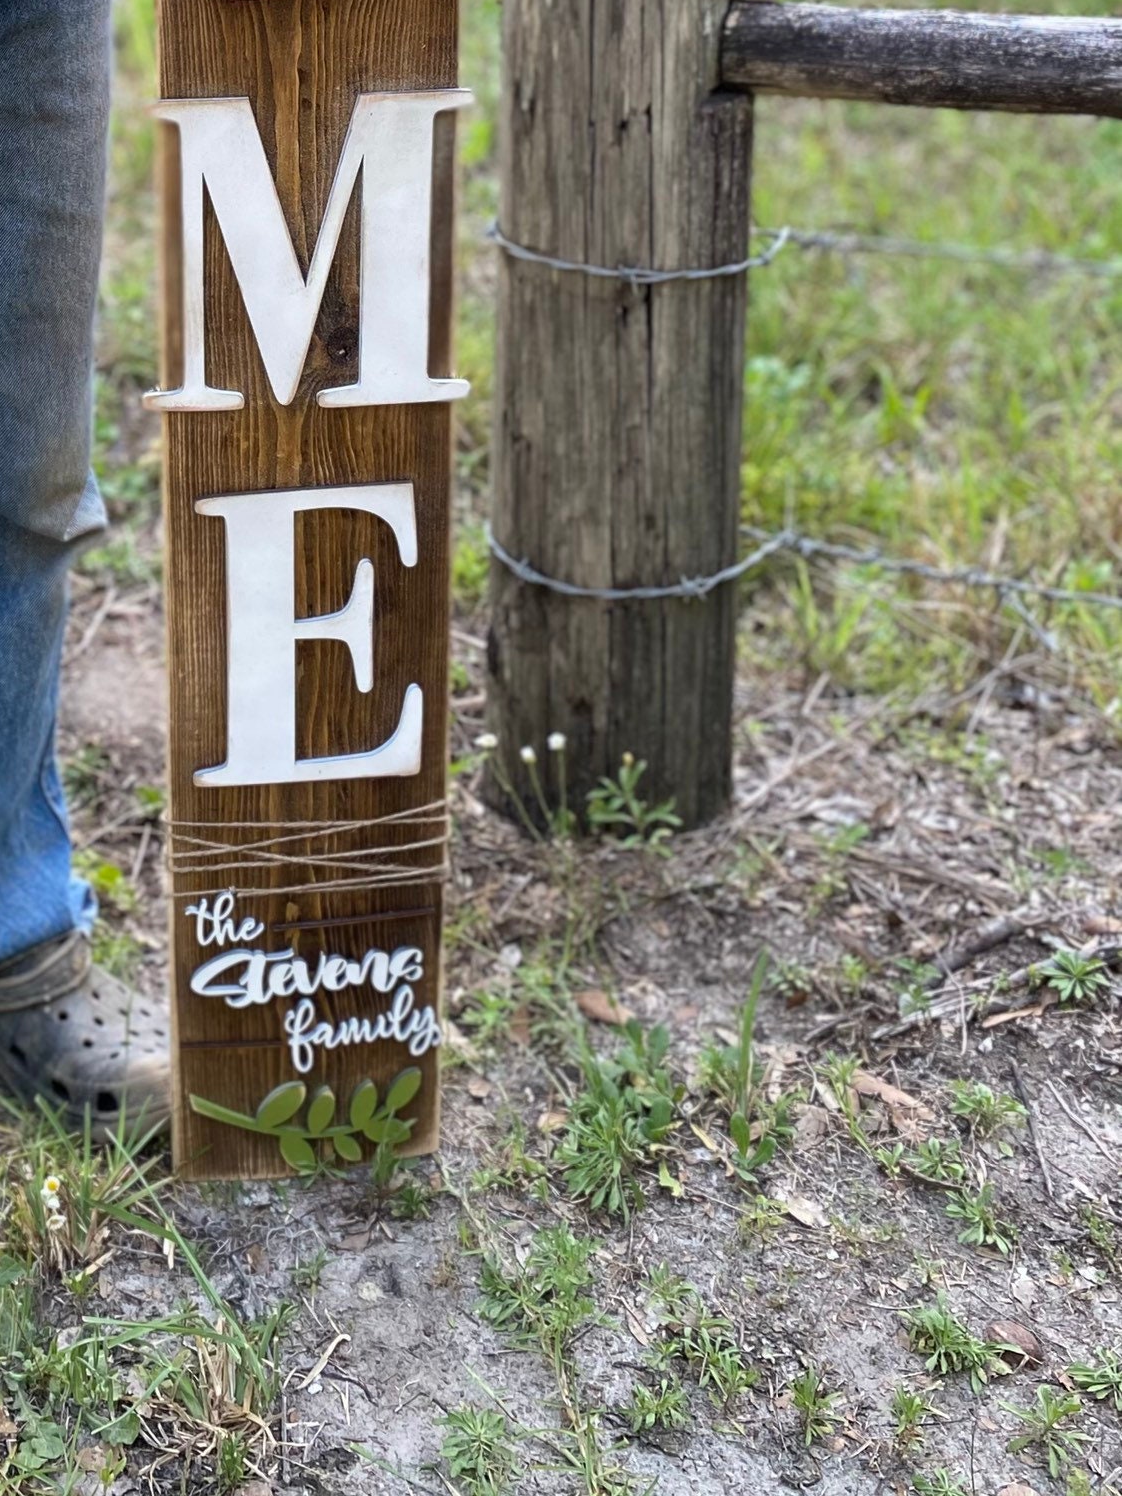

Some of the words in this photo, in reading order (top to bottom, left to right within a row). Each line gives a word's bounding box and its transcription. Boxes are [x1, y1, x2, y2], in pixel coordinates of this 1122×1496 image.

[185, 891, 265, 946] the
[190, 947, 423, 1008] Stevens
[284, 985, 442, 1073] family
